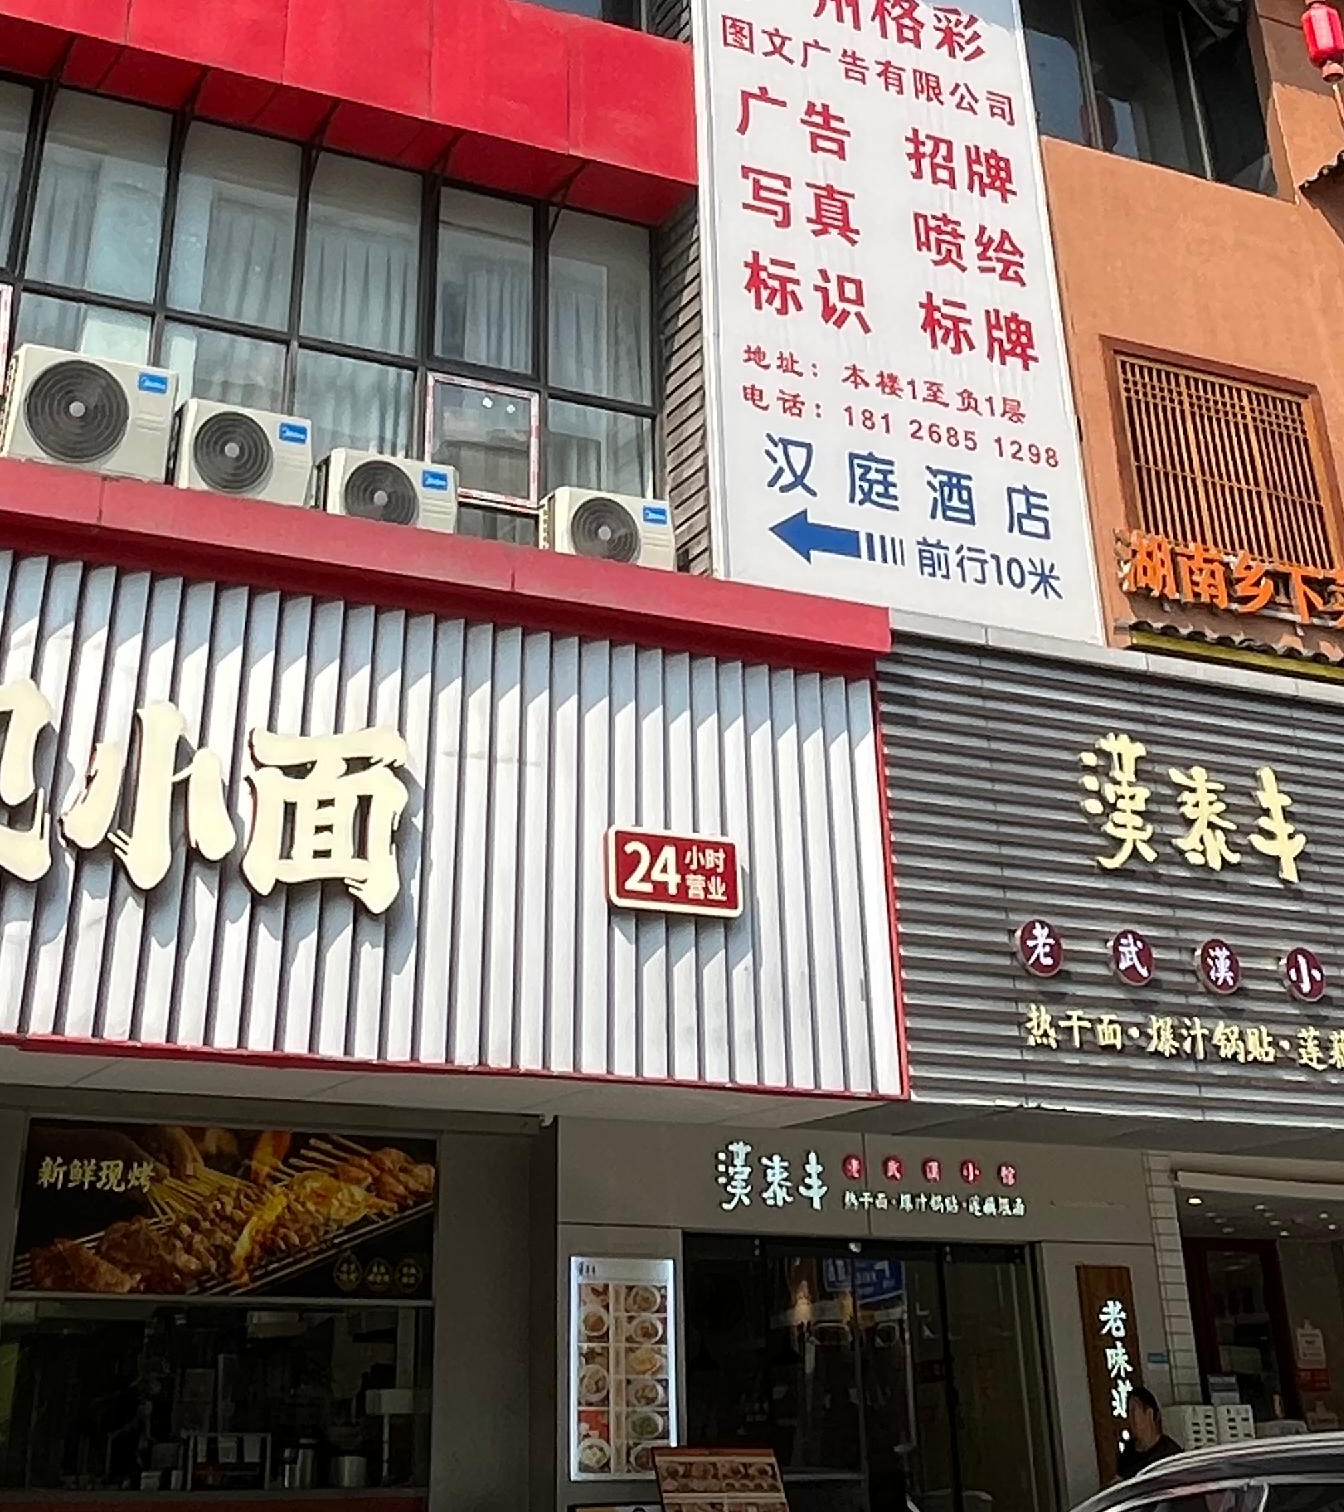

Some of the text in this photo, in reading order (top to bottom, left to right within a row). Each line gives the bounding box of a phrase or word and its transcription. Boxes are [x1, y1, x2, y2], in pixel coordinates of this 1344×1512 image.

[721, 14, 1016, 127] 图文广告有限公司
[736, 86, 1018, 204] 广告 招牌
[741, 165, 1027, 289] 写真 喷绘
[743, 250, 1041, 372] 标识 标牌
[908, 418, 979, 452] 2685
[993, 437, 1059, 469] 1298
[764, 433, 1052, 541] 汉庭酒店
[916, 536, 1064, 600] 前行10米
[623, 840, 726, 896] 24 小时
[684, 873, 728, 902] 营业
[37, 1156, 156, 1193] 新鲜现烤
